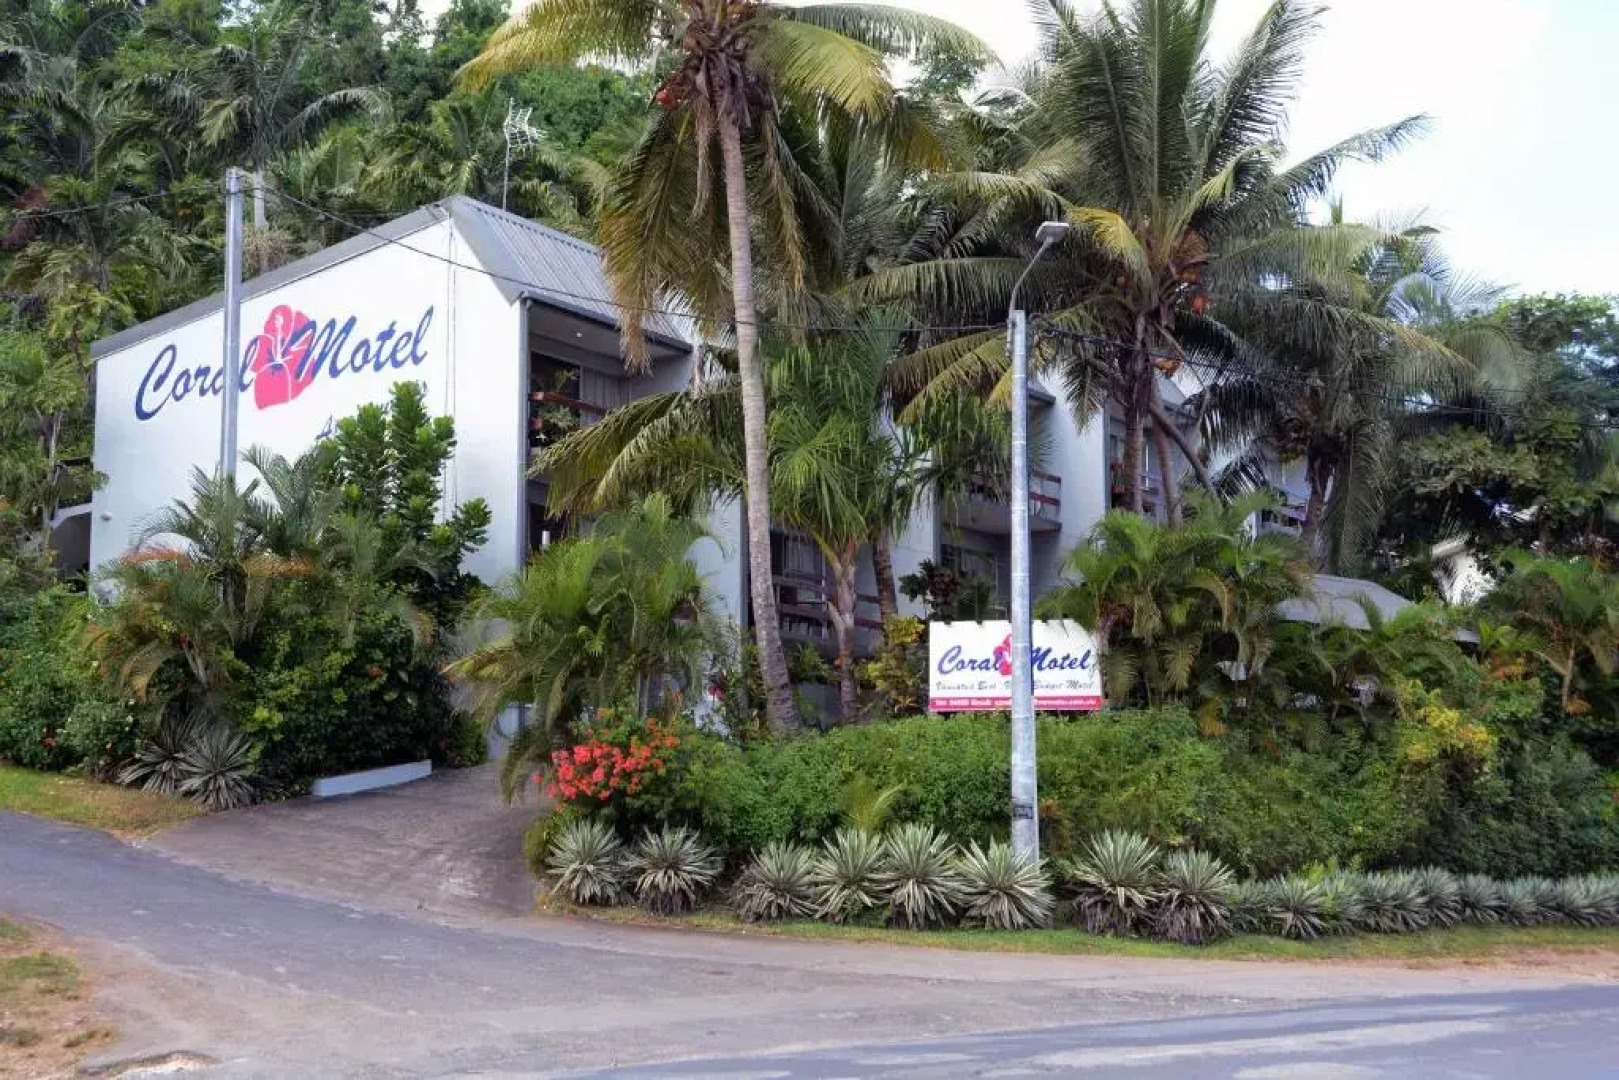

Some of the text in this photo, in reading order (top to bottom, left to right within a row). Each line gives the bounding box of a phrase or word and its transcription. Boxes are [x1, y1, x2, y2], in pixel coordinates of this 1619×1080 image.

[282, 304, 434, 382] Motel
[937, 645, 1092, 675] Coral Motel
